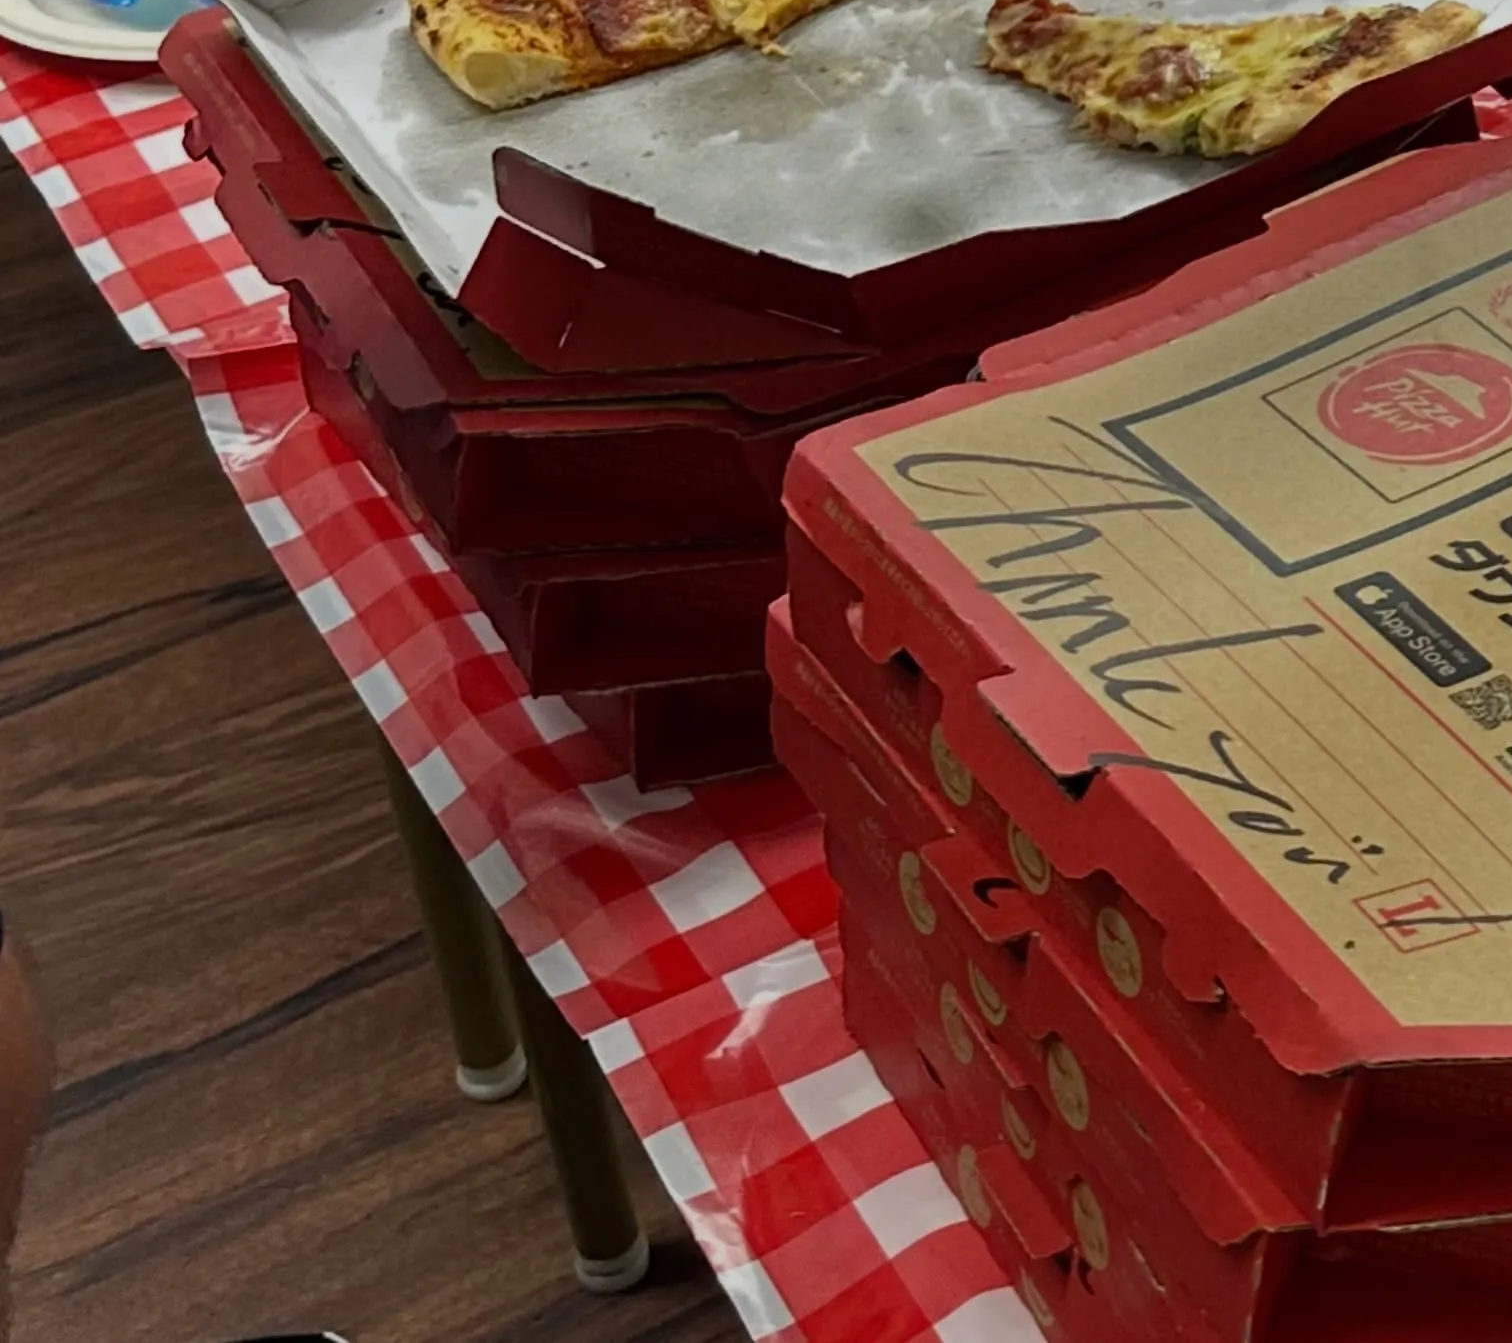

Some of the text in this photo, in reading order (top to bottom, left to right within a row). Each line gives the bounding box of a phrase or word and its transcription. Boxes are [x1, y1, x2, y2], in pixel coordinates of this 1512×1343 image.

[1351, 401, 1437, 436] Hut
[1363, 371, 1463, 428] Pizza
[1374, 607, 1415, 638] App
[1407, 635, 1458, 676] Store
